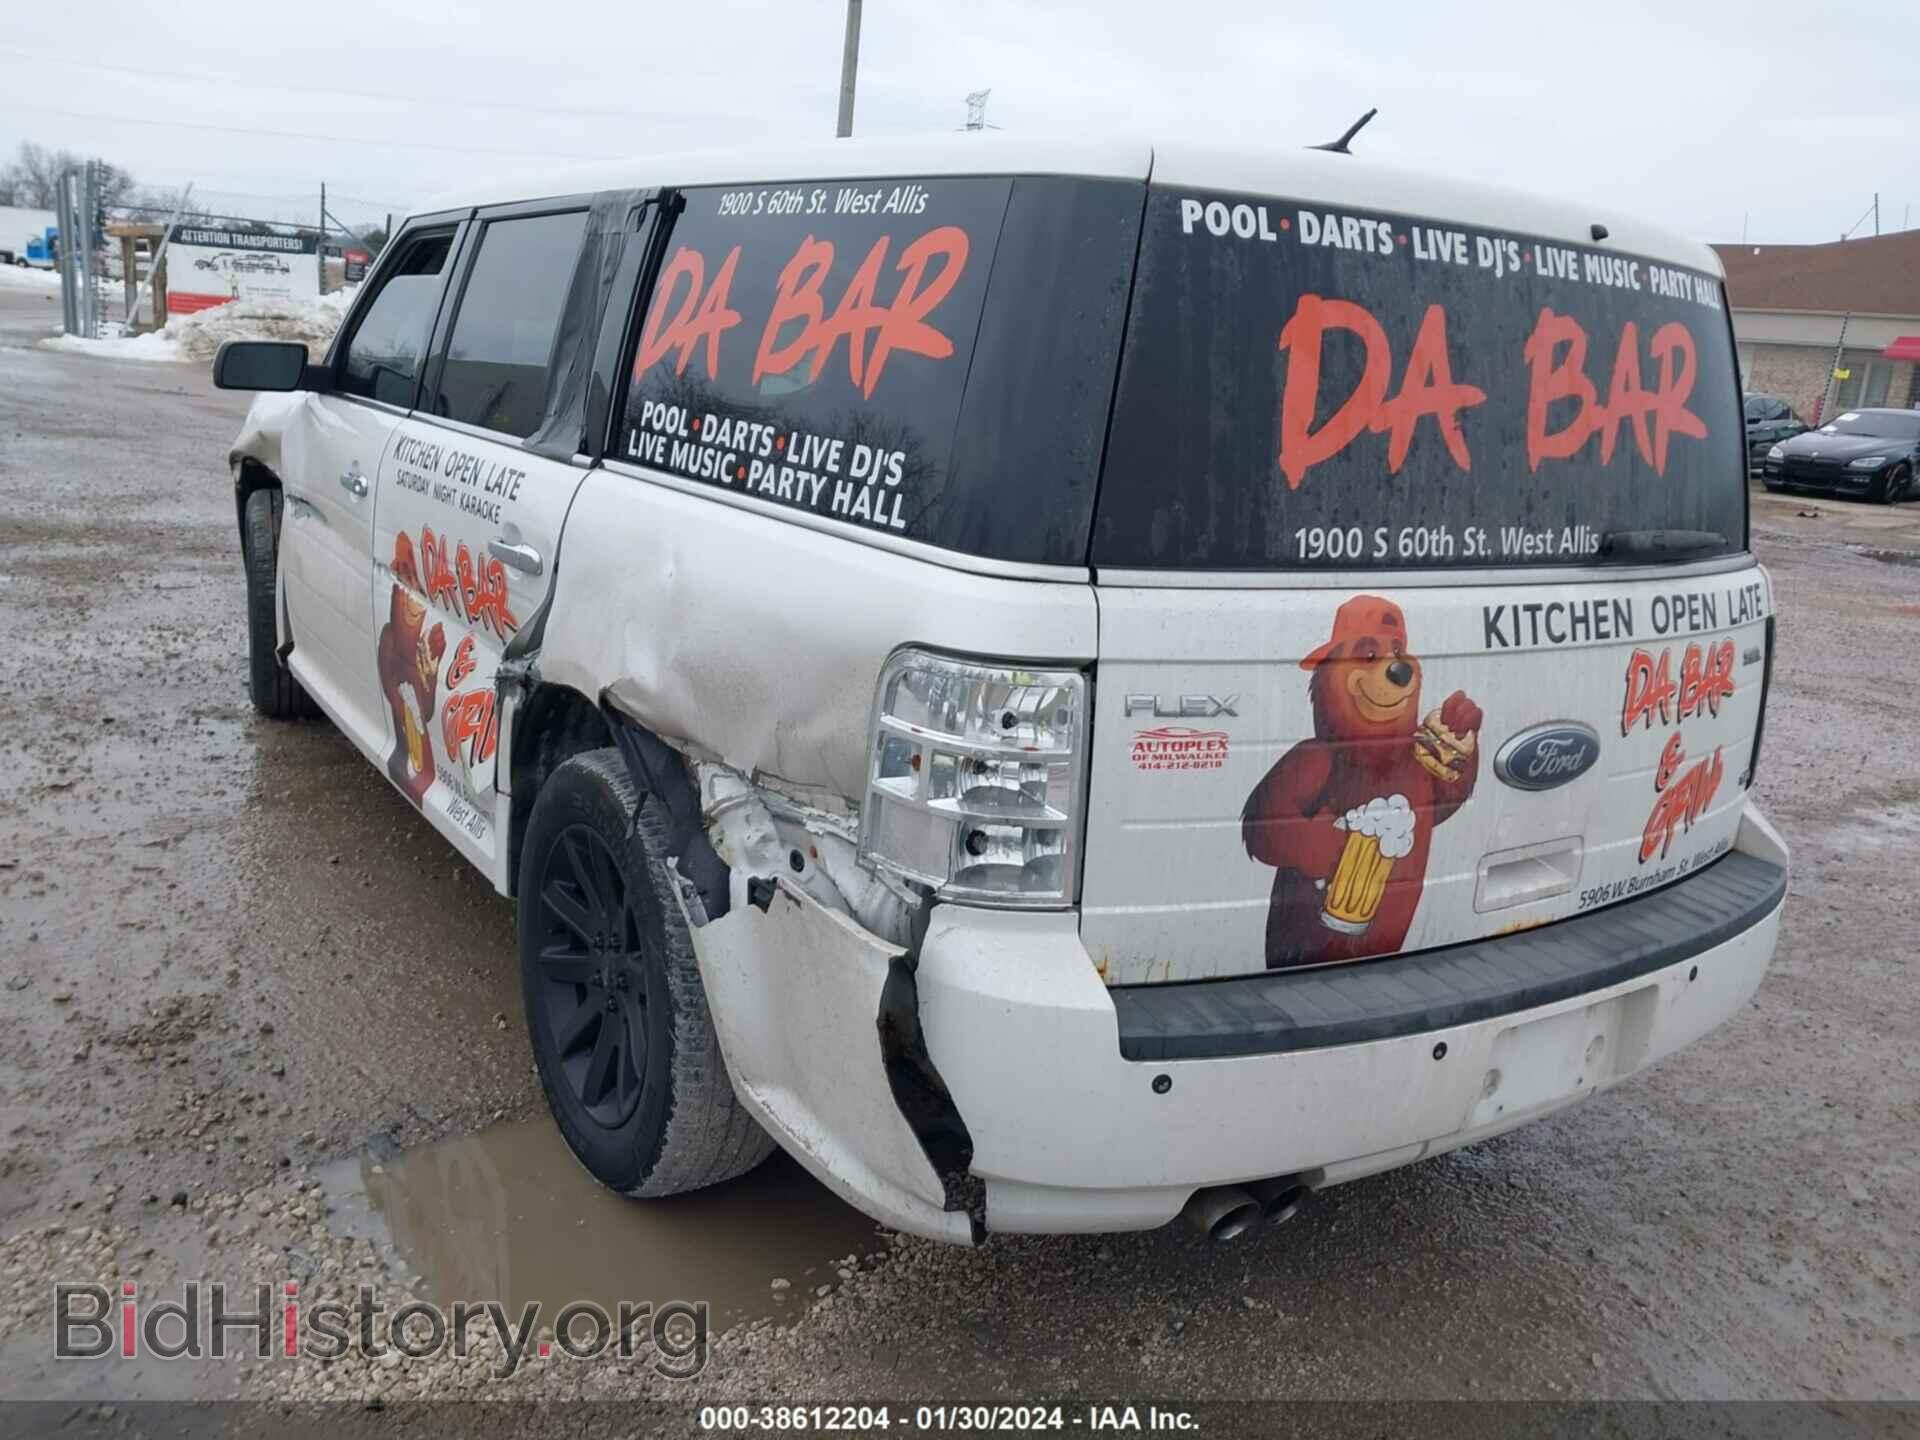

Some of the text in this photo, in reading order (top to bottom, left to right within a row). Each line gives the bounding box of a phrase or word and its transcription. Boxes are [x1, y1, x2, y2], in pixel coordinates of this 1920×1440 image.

[718, 185, 929, 215] 1900 S 60th St. West Allis
[181, 229, 230, 244] ATTENTION
[1180, 199, 1721, 310] POOL DARTS LIVE DJ'S LIVE MUSIC PARTY HALL
[635, 225, 970, 401] DA BAR
[1278, 294, 1708, 491] DA BAR
[393, 435, 526, 501] KITCHEN OPEN LATE
[640, 400, 906, 487] POOL DARTS LIVE DJ'S
[396, 469, 502, 525] SATURDAY NIGHT KARAOKE
[627, 430, 906, 529] LIVE MUSIC PARTY HALL
[1294, 525, 1600, 559] 1900 S 60th St. West Allis
[421, 523, 520, 645] DA BAR
[1482, 583, 1762, 649] KITCHEN OPEN LATE
[1124, 693, 1240, 718] FLEX
[1621, 638, 1735, 738] DA BAR
[1131, 752, 1229, 761] OF MILWAUKEE
[1132, 739, 1229, 753] AUTOPLEX
[1529, 738, 1585, 778] Ford
[446, 797, 469, 825] West
[1578, 883, 1610, 909] 5906
[1627, 866, 1676, 892] Burnham
